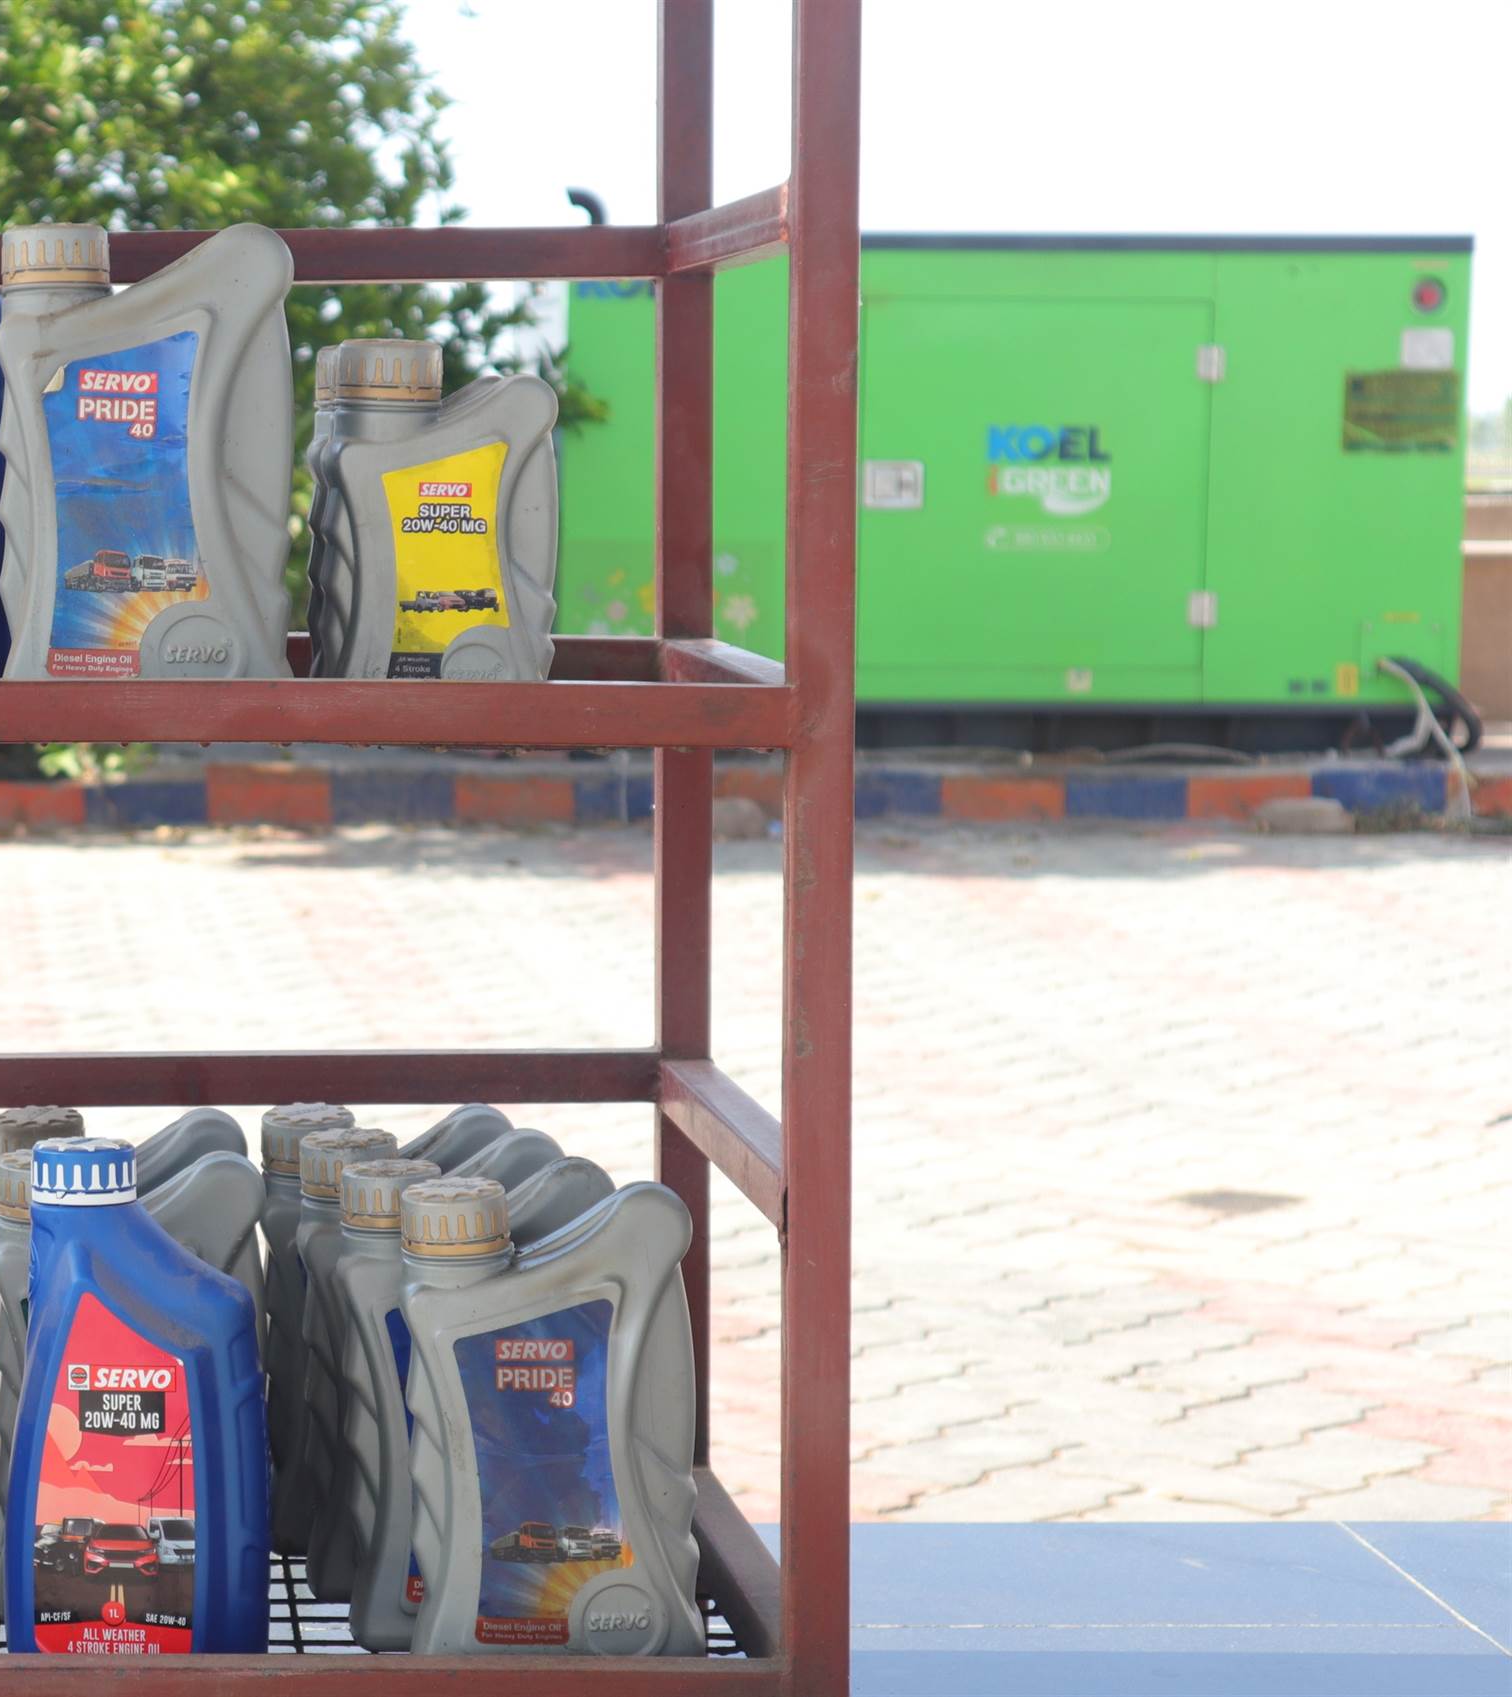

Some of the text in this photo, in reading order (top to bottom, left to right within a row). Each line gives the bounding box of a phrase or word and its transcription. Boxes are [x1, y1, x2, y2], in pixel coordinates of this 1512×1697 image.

[81, 372, 151, 392] SERVO
[79, 398, 155, 420] PRIDE
[130, 423, 154, 437] 40
[988, 425, 1111, 461] KOEL
[420, 483, 468, 496] SERVO
[419, 504, 471, 518] SUPER
[402, 519, 487, 533] 20W-40 MG
[54, 653, 132, 664] Diesel Engine Oil
[164, 646, 228, 664] SERVO
[402, 664, 431, 673] Stroke
[498, 1342, 567, 1360] SERVO
[94, 1368, 172, 1388] SERVO
[497, 1368, 574, 1390] PRIDE
[103, 1394, 141, 1411] SUPER
[550, 1391, 573, 1406] 40
[85, 1411, 159, 1430] 20W-40 MG
[145, 1613, 187, 1626] SAE 20W-40
[589, 1614, 651, 1632] SERVO
[83, 1628, 146, 1642] ALL WEATHER
[67, 1641, 73, 1653] 4
[76, 1642, 110, 1654] STROKE
[113, 1642, 145, 1654] ENGINE
